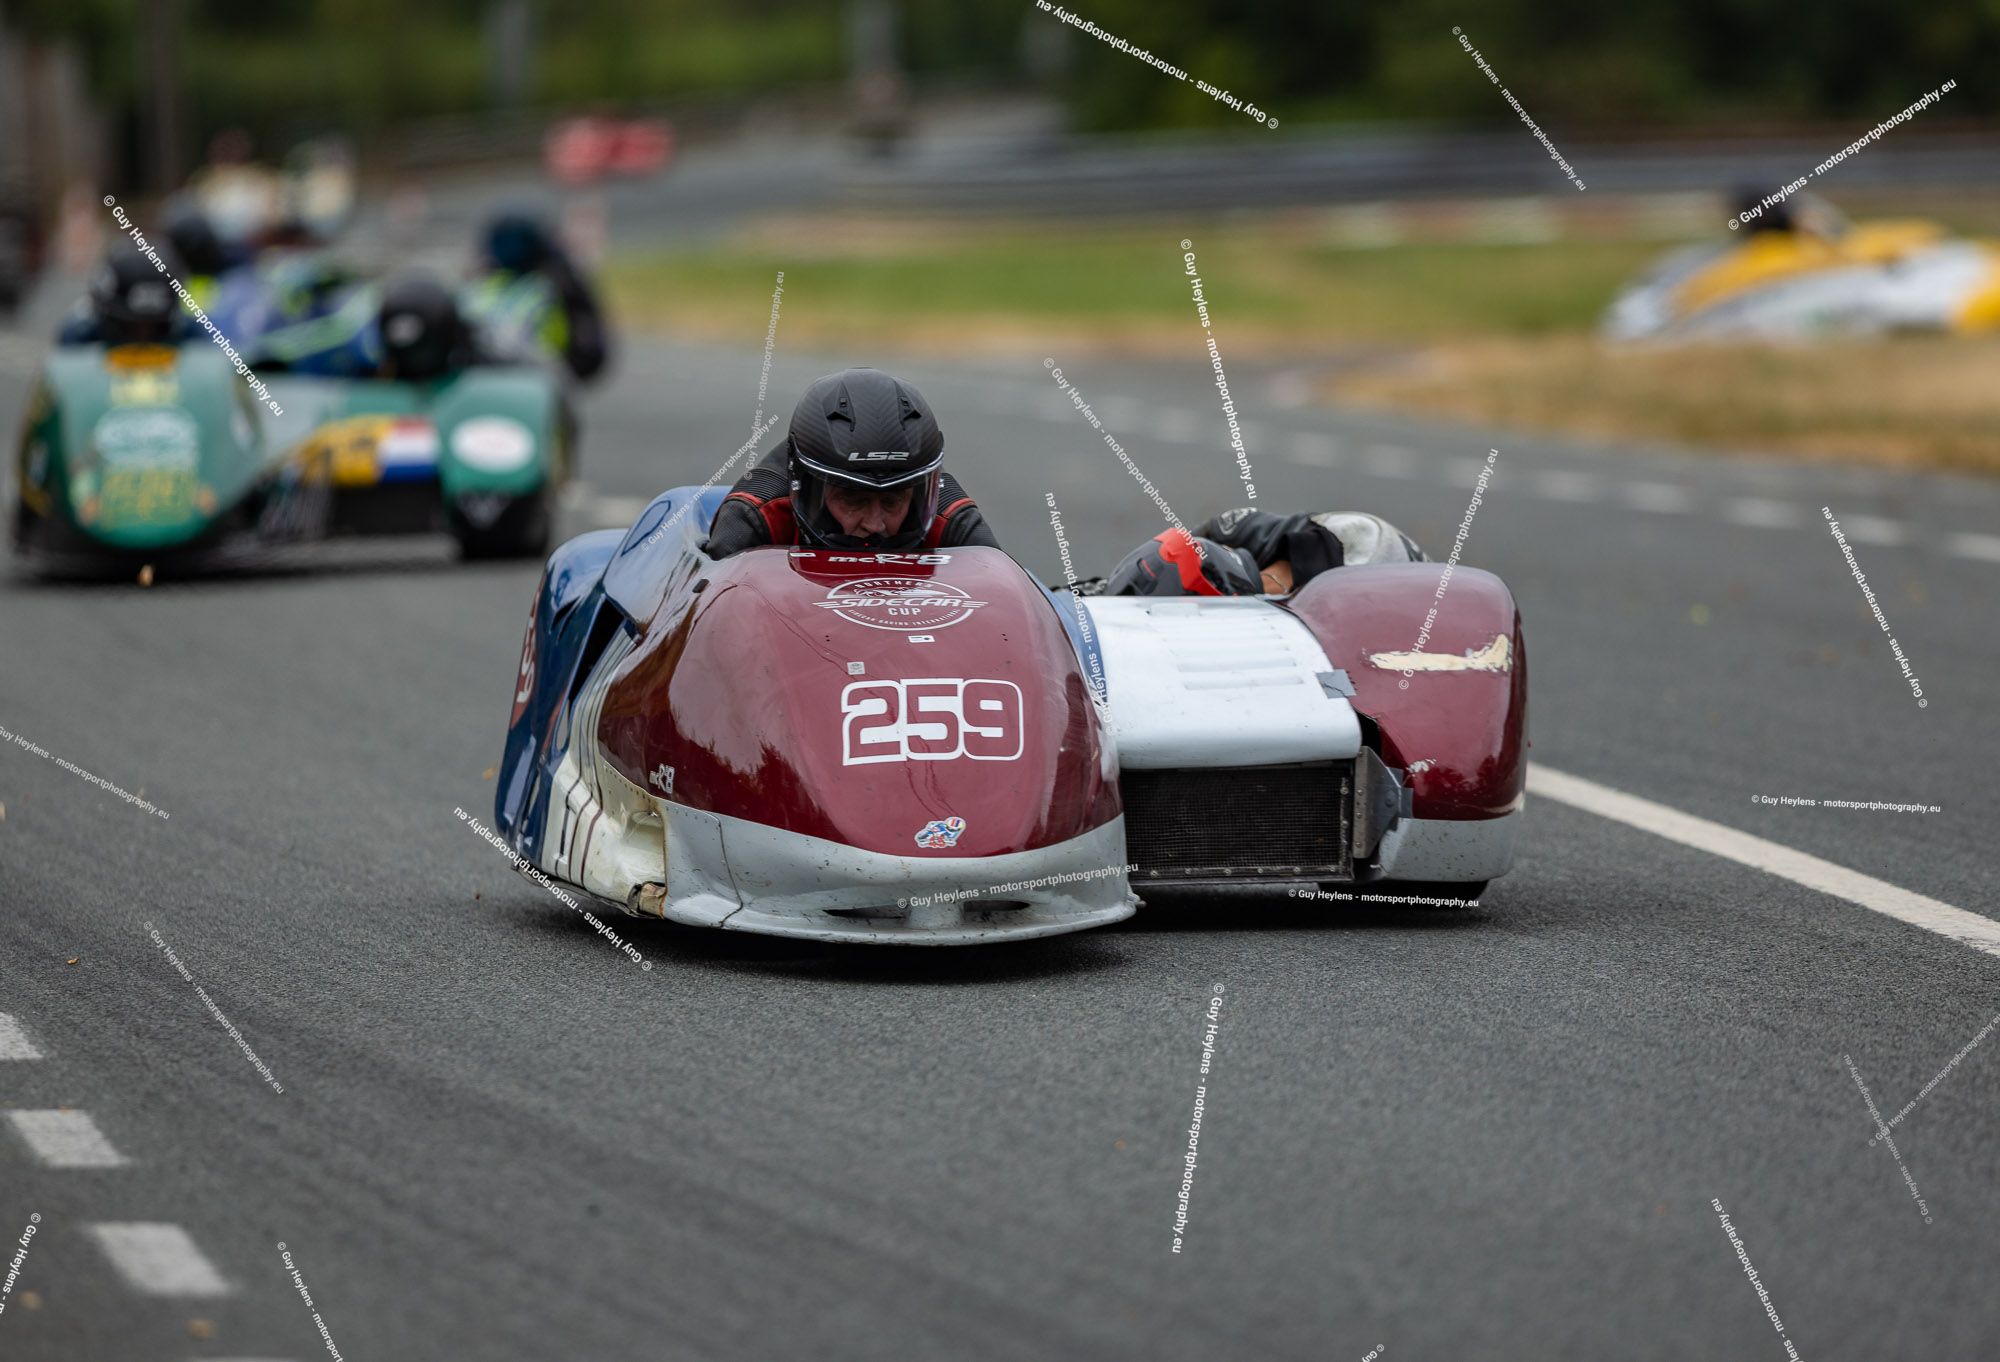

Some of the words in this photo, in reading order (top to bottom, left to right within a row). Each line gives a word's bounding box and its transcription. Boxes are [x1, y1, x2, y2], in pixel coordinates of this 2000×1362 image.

[848, 451, 910, 462] LS2
[855, 580, 934, 588] NORTHERN
[840, 597, 963, 608] SIDECAR
[888, 608, 921, 616] CUP
[841, 678, 1024, 766] 259
